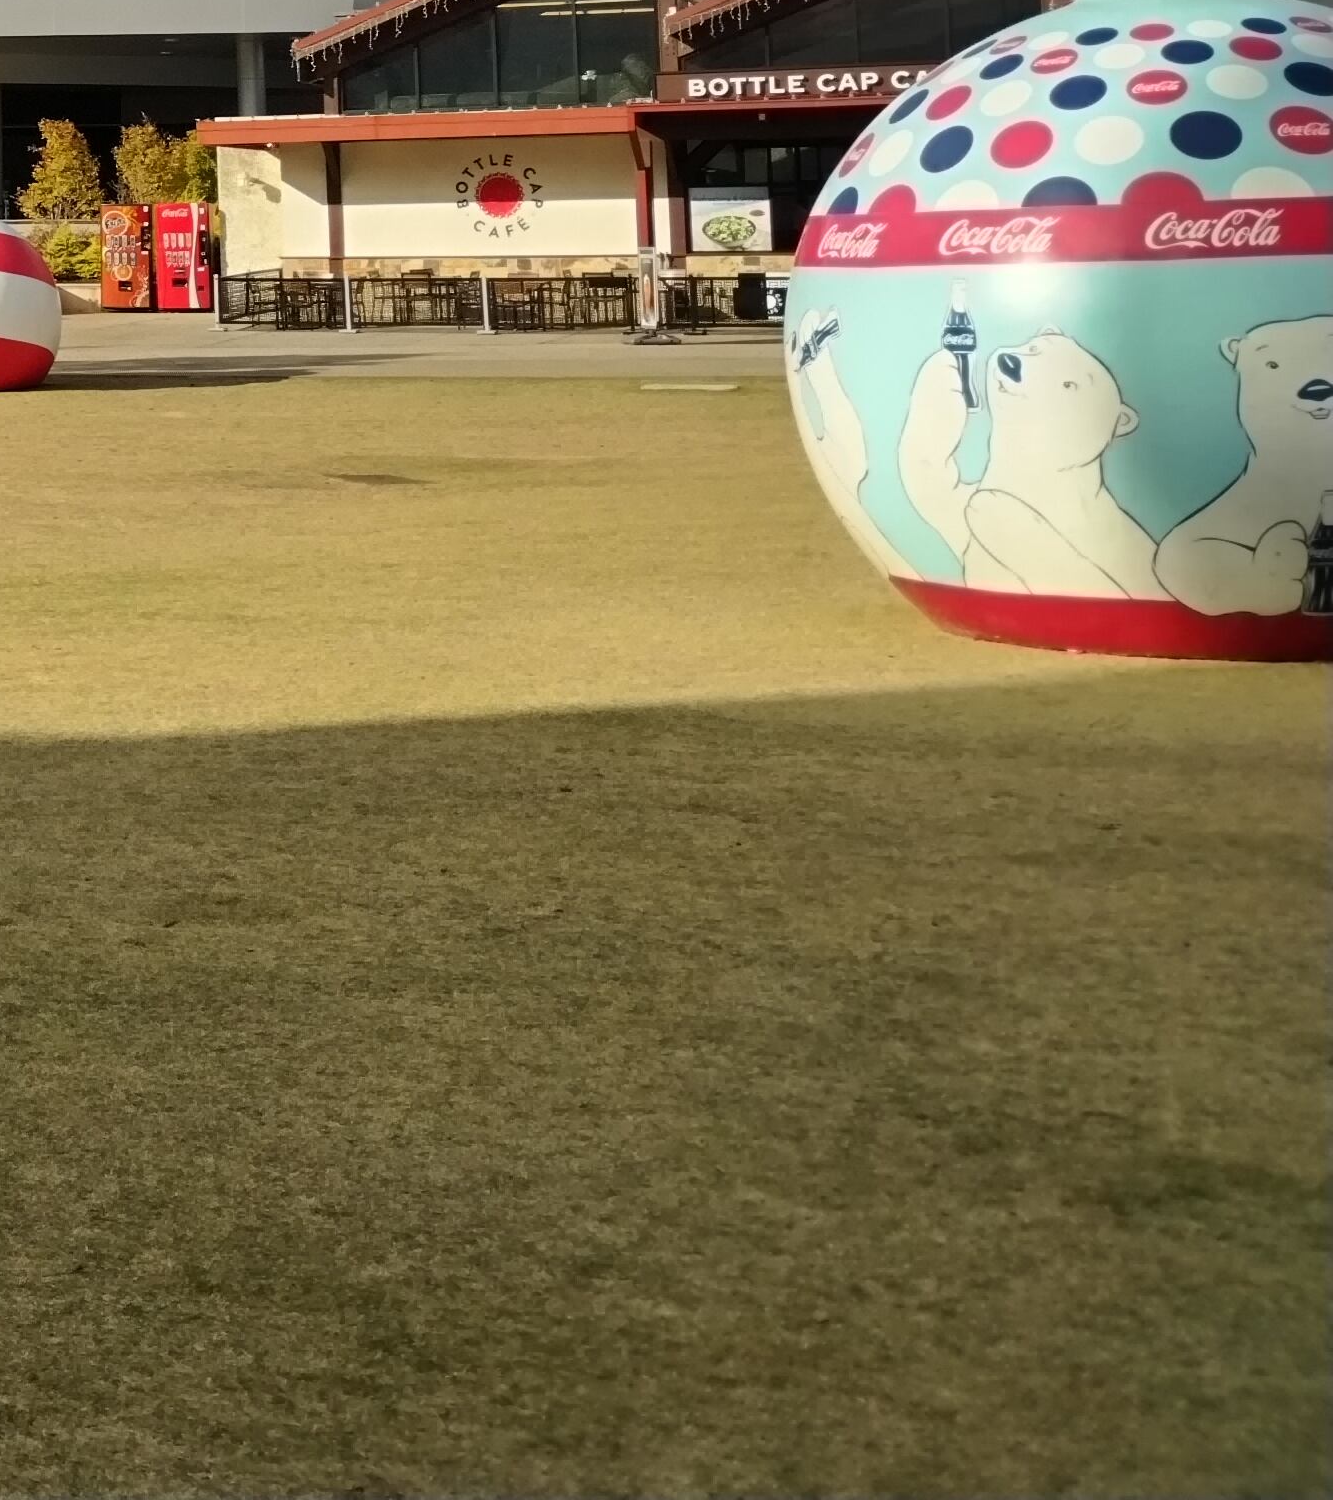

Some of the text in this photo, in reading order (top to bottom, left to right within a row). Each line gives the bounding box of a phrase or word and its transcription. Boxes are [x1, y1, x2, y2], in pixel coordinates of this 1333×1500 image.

[688, 75, 805, 97] BOTTLE
[816, 72, 879, 92] CAP
[1131, 80, 1182, 94] Coca-Cola
[1277, 122, 1331, 137] Coca-Cola
[455, 154, 544, 209] BOTTLE CAP
[473, 216, 531, 238] CAFÉ
[817, 223, 889, 258] Coca-Cola
[938, 216, 1062, 256] Coca-Cola
[1144, 208, 1285, 249] Coca-Cola
